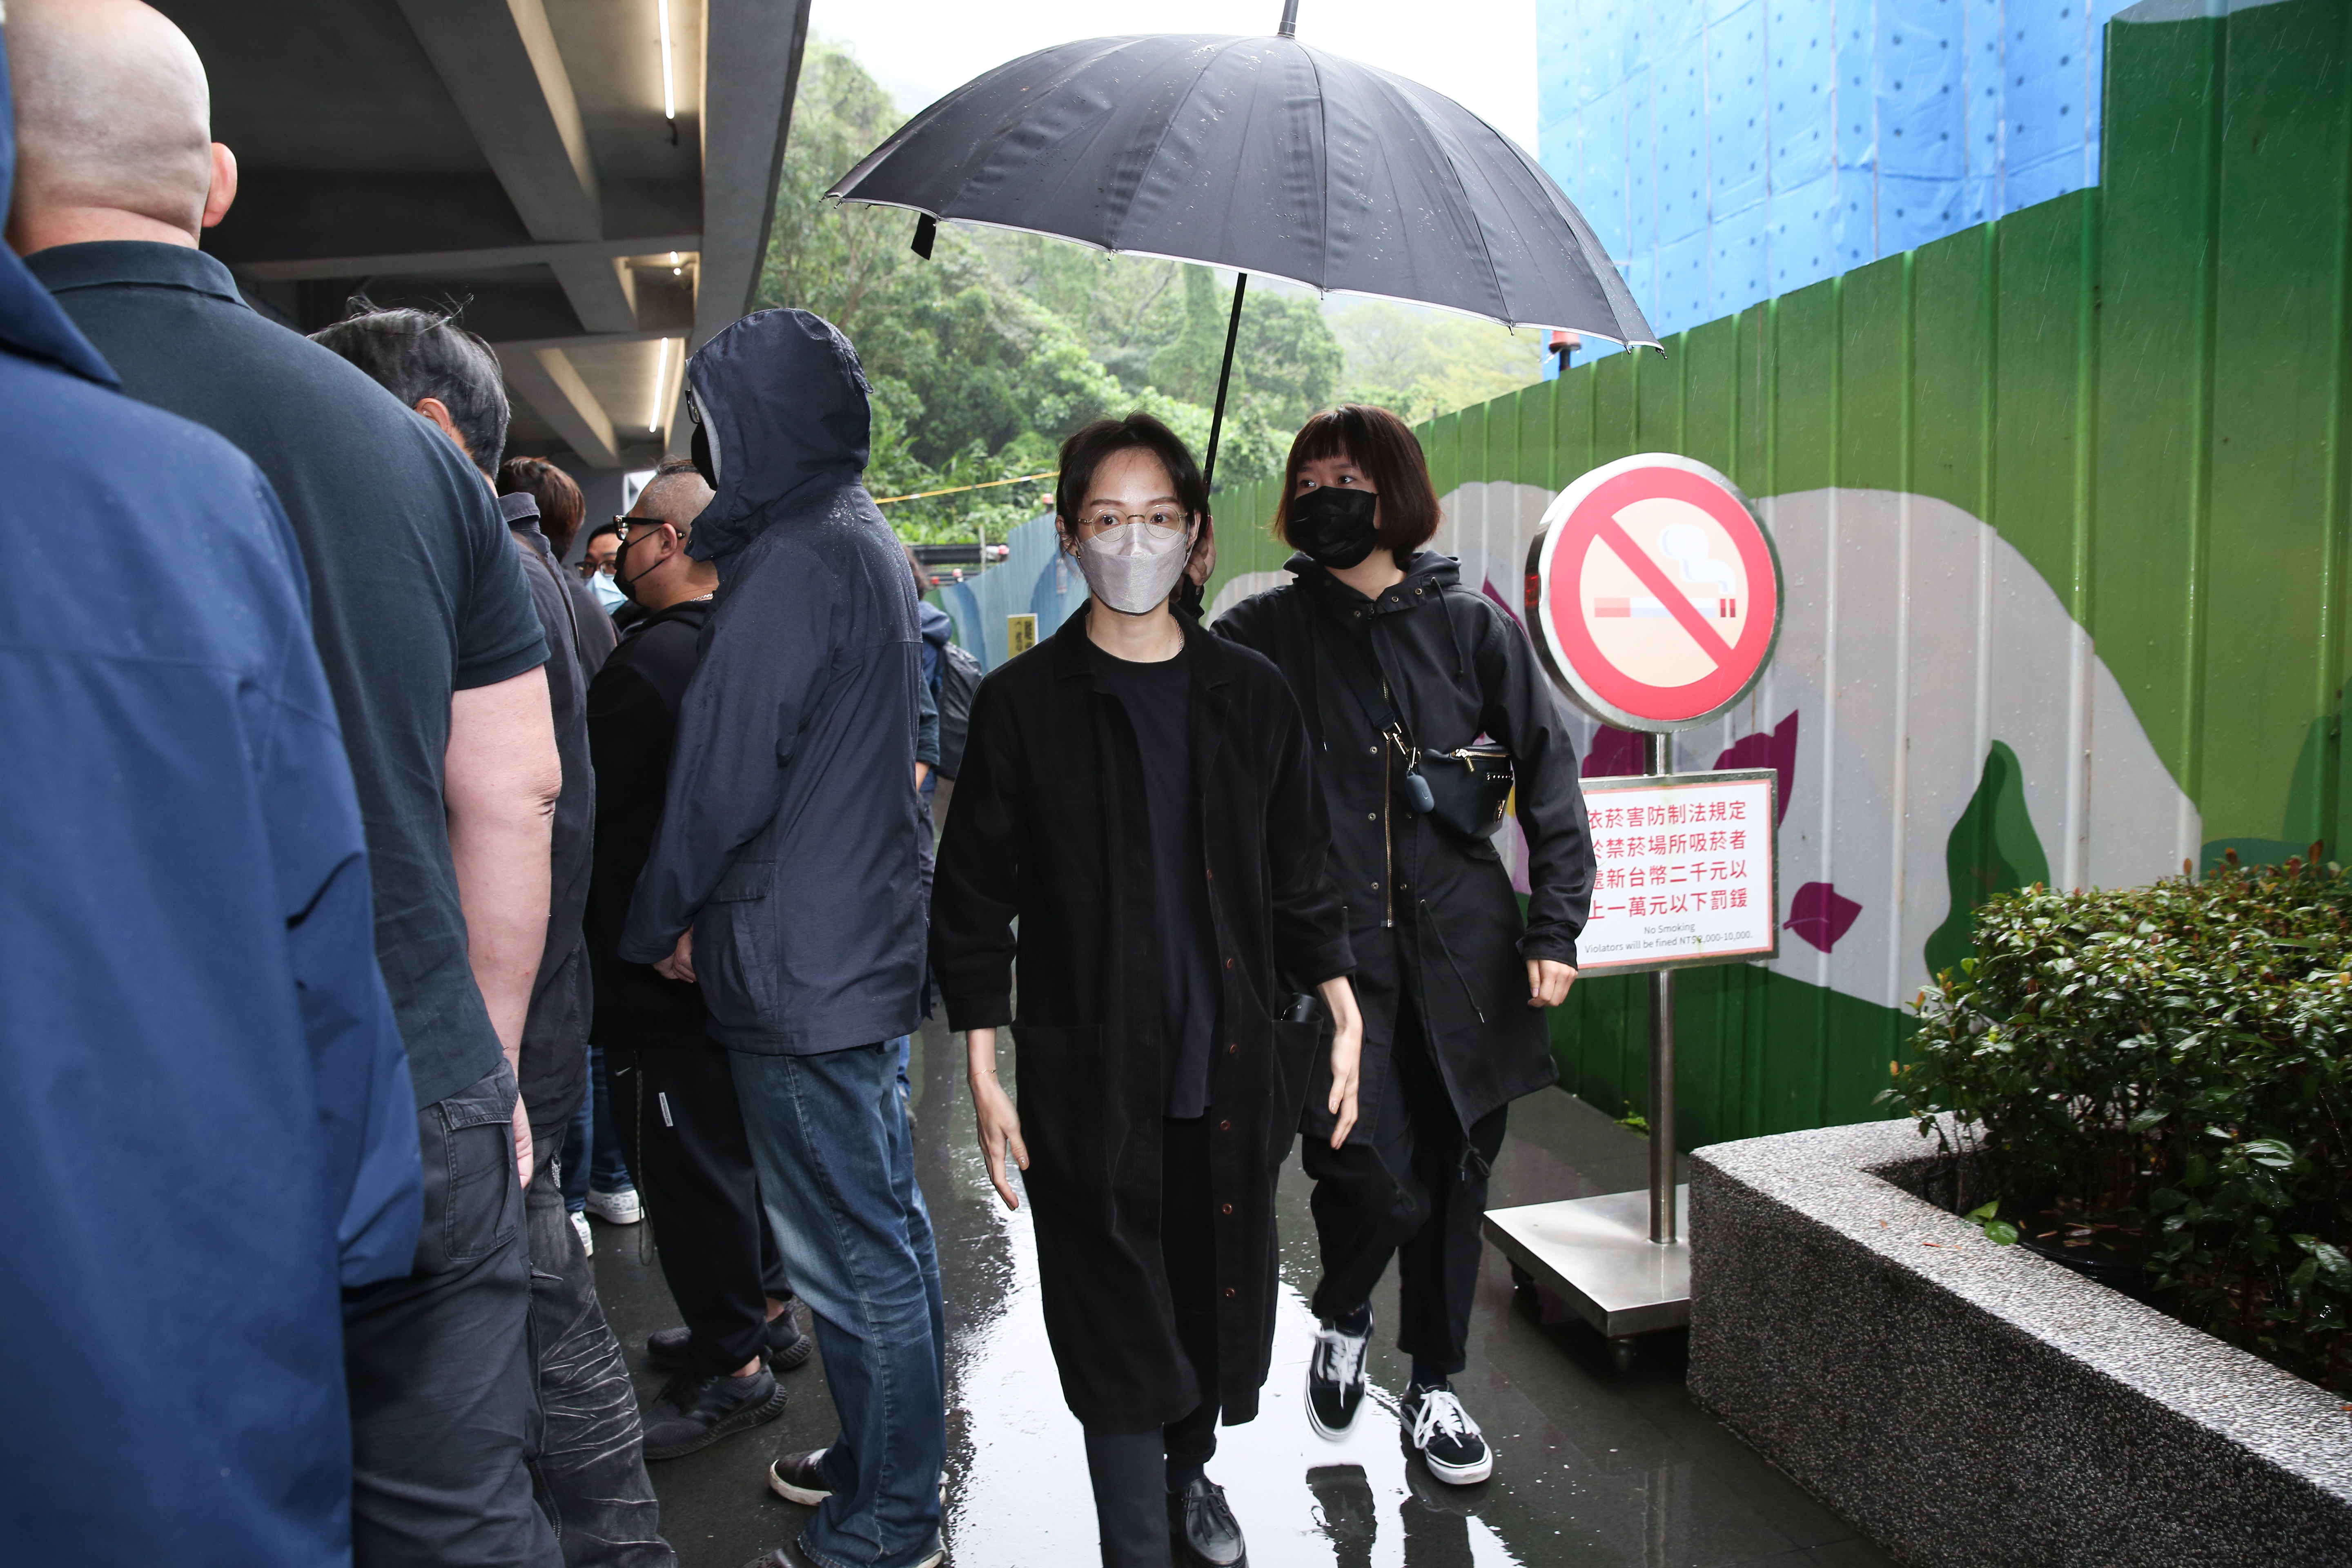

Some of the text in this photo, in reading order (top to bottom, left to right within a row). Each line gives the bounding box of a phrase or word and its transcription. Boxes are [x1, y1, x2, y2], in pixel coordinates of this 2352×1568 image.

[1587, 800, 1746, 829] 依菸害防制法規定
[1588, 888, 1748, 920] 上一萬元以下罰鍰
[1644, 922, 1695, 934] No Smoking
[1585, 944, 1624, 953] Violators
[1626, 940, 1641, 949] will
[1643, 940, 1653, 948] be
[1656, 937, 1677, 947] fined
